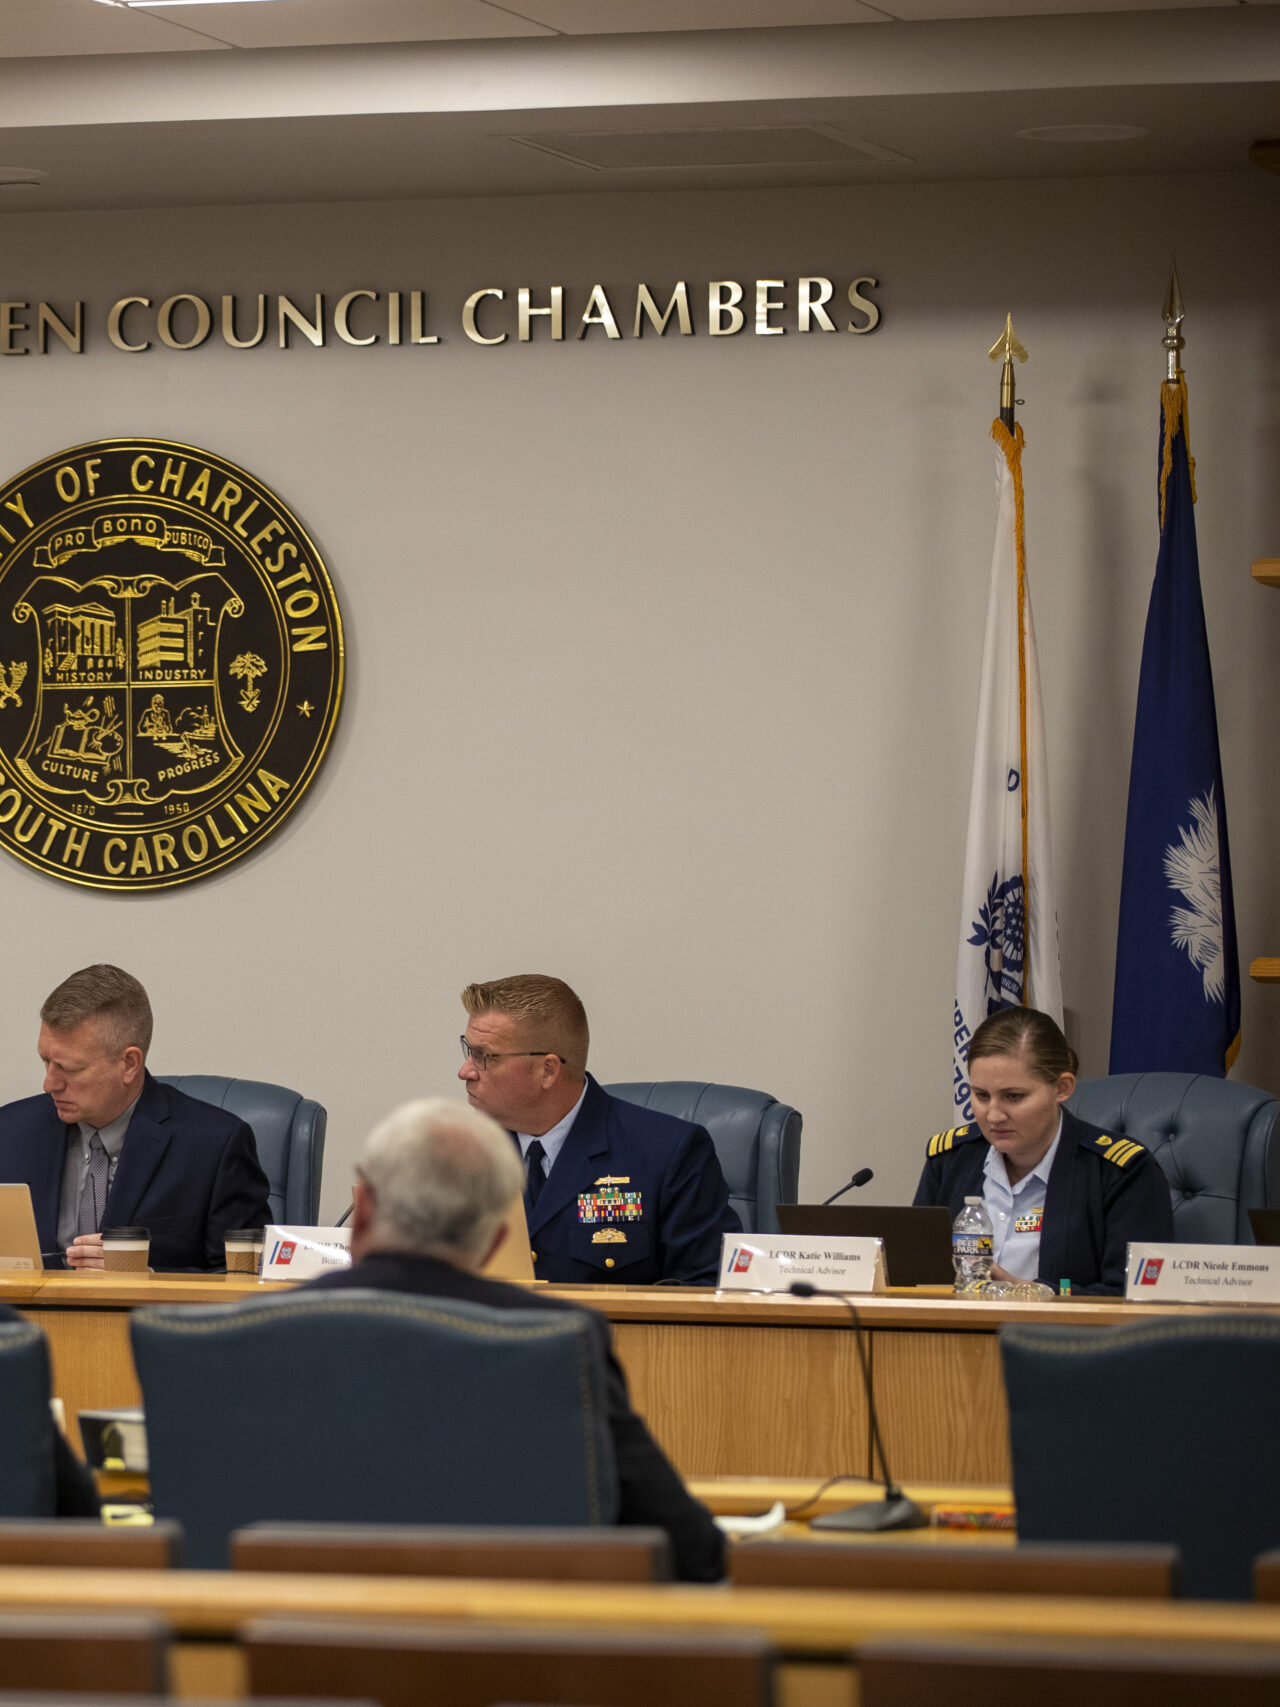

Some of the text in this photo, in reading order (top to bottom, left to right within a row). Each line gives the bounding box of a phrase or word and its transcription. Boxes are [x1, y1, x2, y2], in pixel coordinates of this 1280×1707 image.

[105, 289, 441, 353] COUNCIL
[461, 275, 883, 346] CHAMBERS
[54, 531, 86, 551] PRO
[165, 530, 209, 550] PUBLICO
[55, 457, 102, 503] OF
[130, 454, 329, 653] CHARLESTON
[55, 671, 114, 683] HISTORY
[138, 668, 208, 681] INDUSTRY
[41, 758, 100, 783] CULTURE
[157, 751, 221, 782] PROGRESS
[103, 768, 291, 876] CAROLINA
[798, 1251, 822, 1260] Katie
[823, 1252, 861, 1261] Williams
[956, 1246, 979, 1254] PARK
[779, 1265, 847, 1276] Technical Advisor
[1172, 1260, 1270, 1272] LCDR Nicole Emmons
[1184, 1275, 1253, 1287] Technical Advisor
